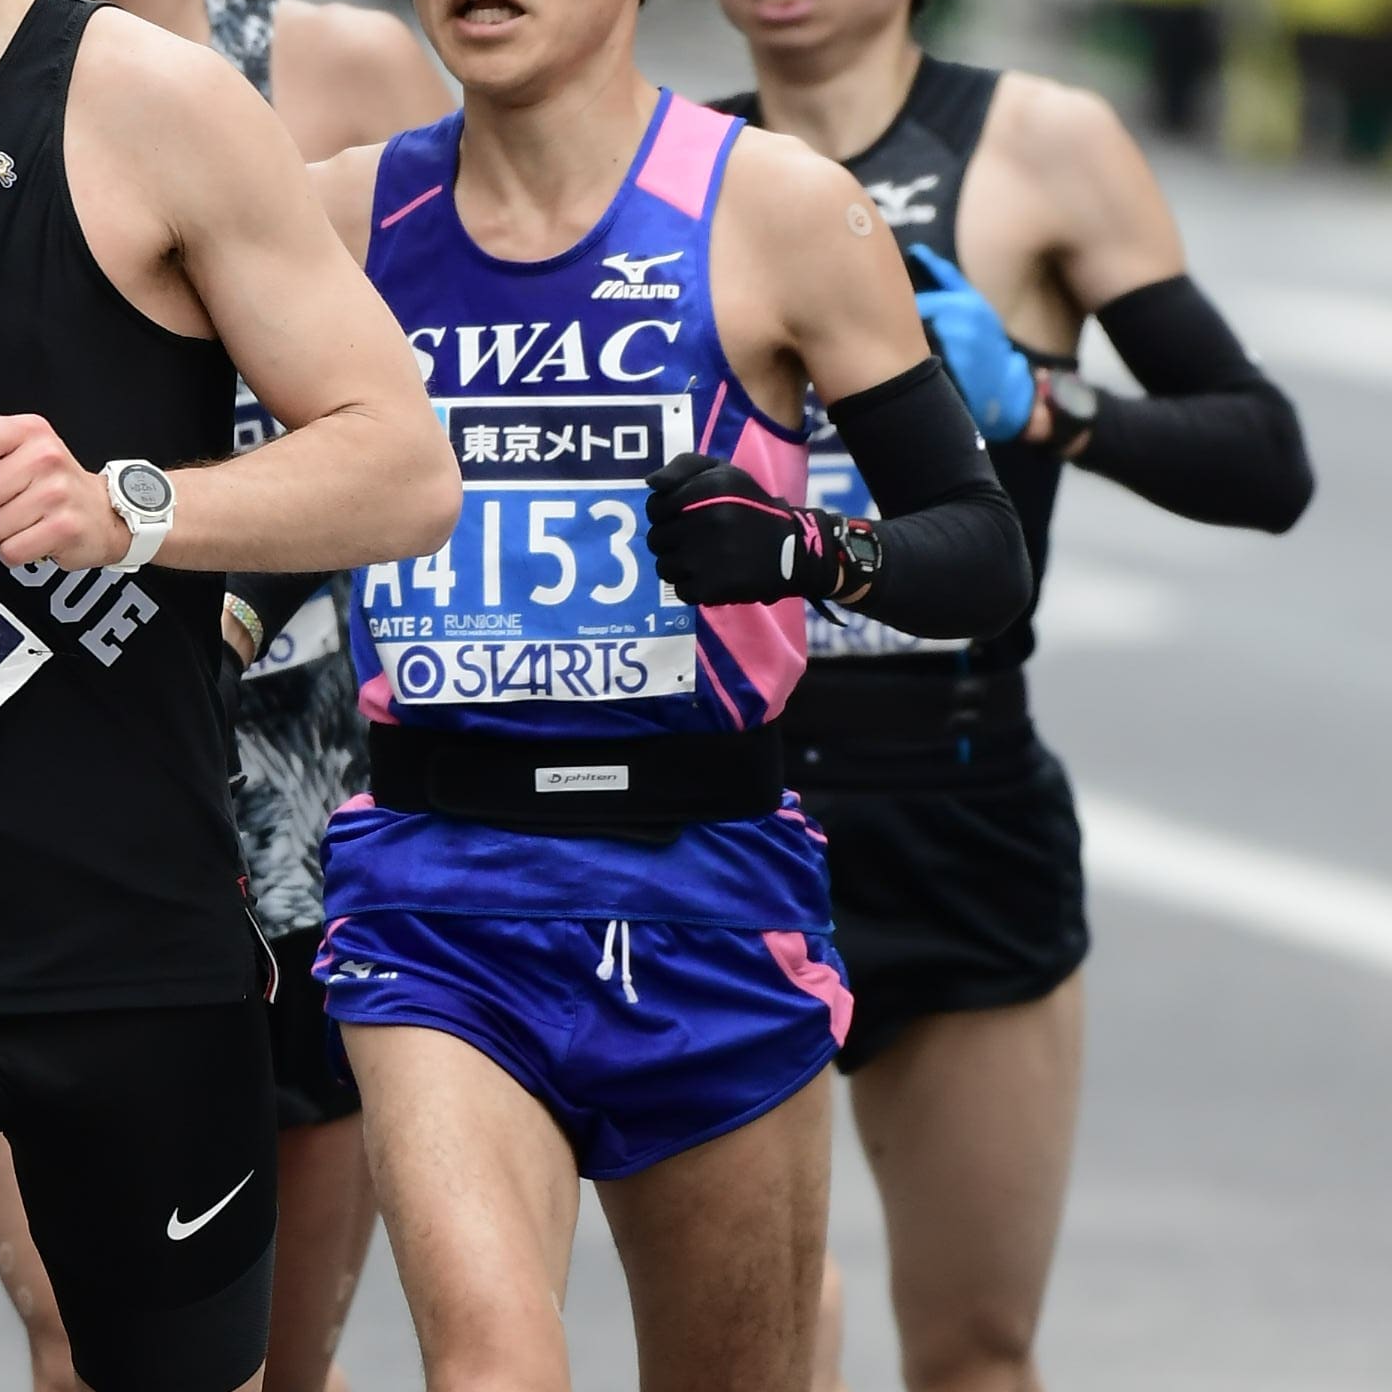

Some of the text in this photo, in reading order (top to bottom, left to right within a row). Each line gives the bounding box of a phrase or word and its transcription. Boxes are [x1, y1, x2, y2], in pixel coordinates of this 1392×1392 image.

[591, 280, 680, 300] MIZUNO
[407, 319, 683, 387] SWAC
[462, 424, 649, 463] 東京メトロ
[369, 616, 433, 638] GATE 2
[453, 641, 648, 698] STARTS
